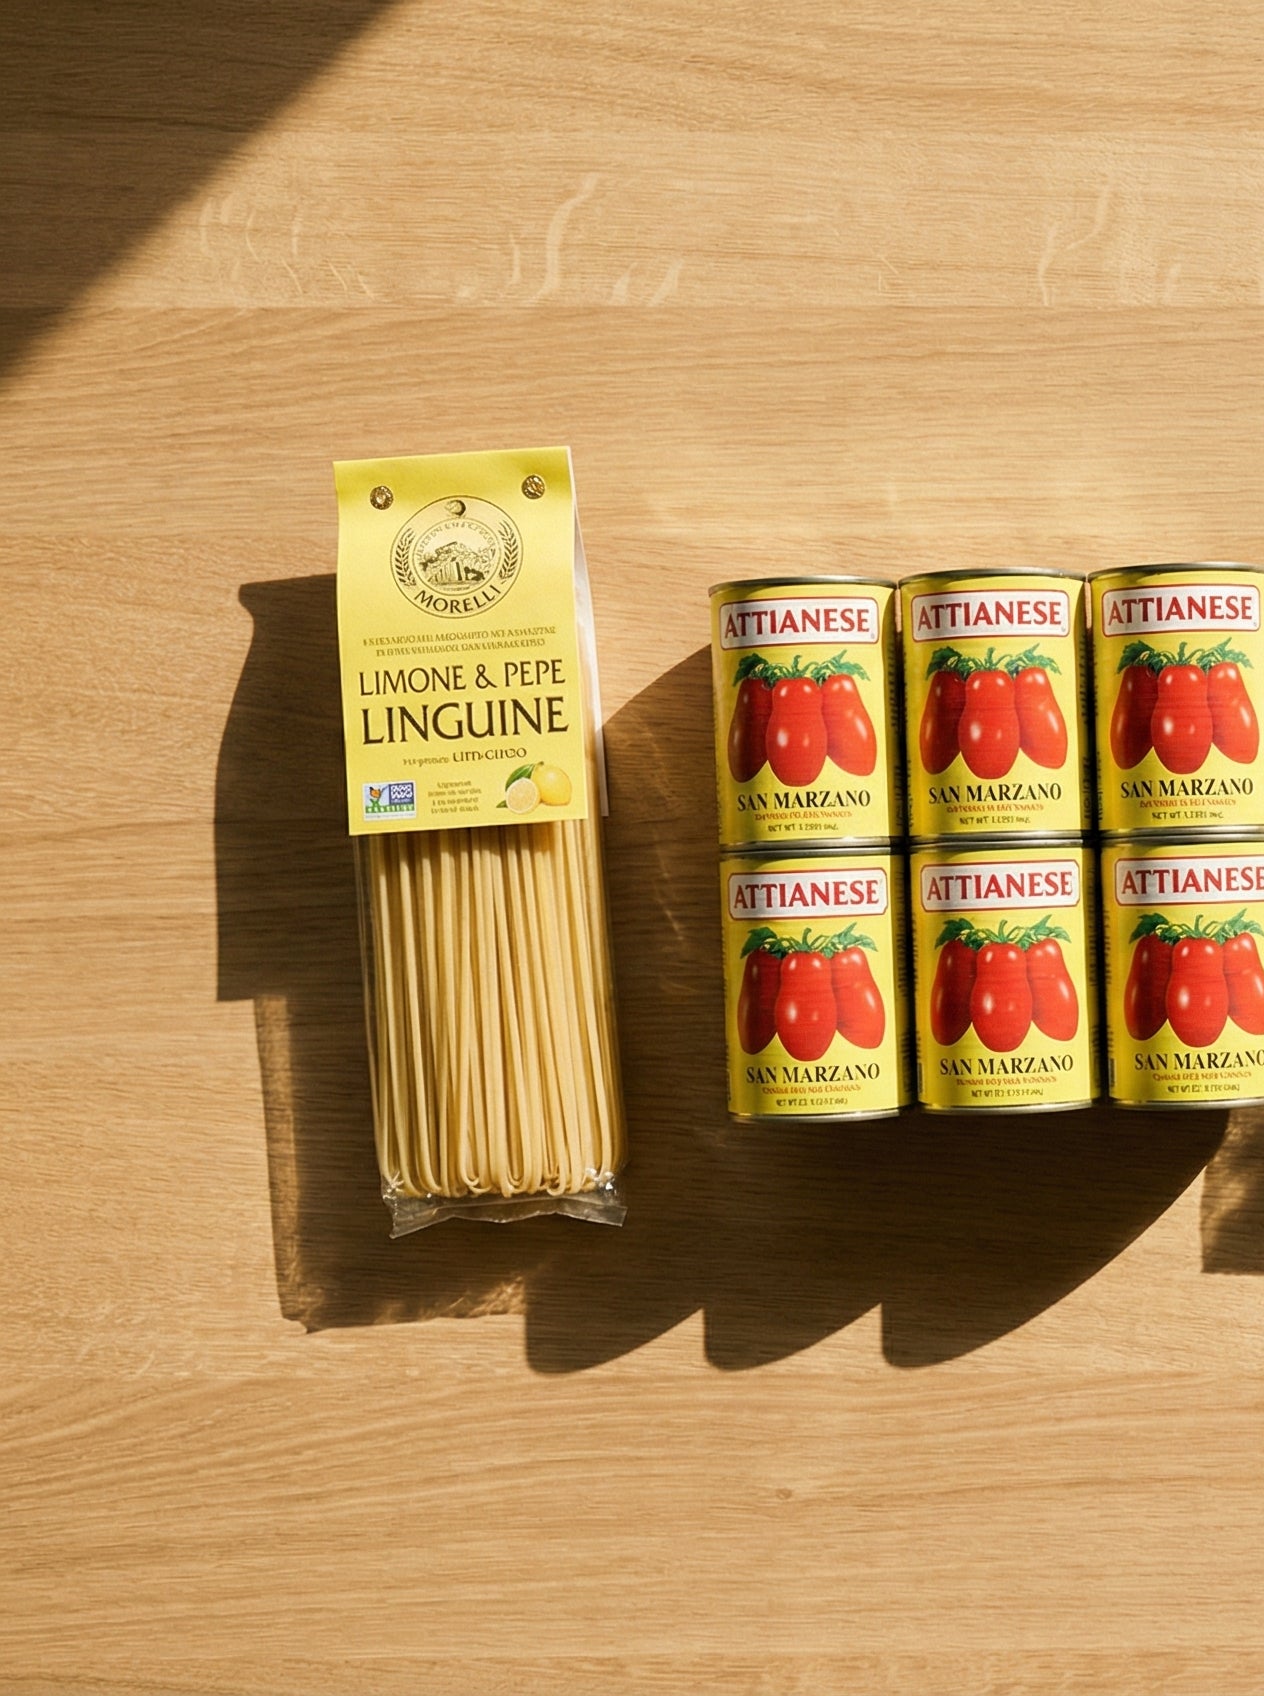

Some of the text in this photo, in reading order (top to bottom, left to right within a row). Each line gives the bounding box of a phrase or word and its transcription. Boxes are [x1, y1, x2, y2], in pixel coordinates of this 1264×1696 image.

[414, 584, 502, 614] MORELLI
[1108, 595, 1253, 626] ATTIANESE
[725, 608, 870, 639] ATTIANESE
[917, 601, 1062, 631] ATTIANESE
[359, 659, 566, 697] LIMONE & PEPE
[361, 696, 569, 745] LINGUINE
[737, 790, 871, 812] SAN MARZANO
[929, 783, 1062, 804] SAN MARZANO
[1120, 778, 1254, 798] SAN MARZANO
[734, 879, 880, 909] ATTIANESE
[927, 871, 1073, 901] ATTIANESE
[747, 1062, 880, 1084] SAN MARZANO
[940, 1054, 1074, 1076] SAN MARZANO
[1135, 1053, 1168, 1071] SAN
